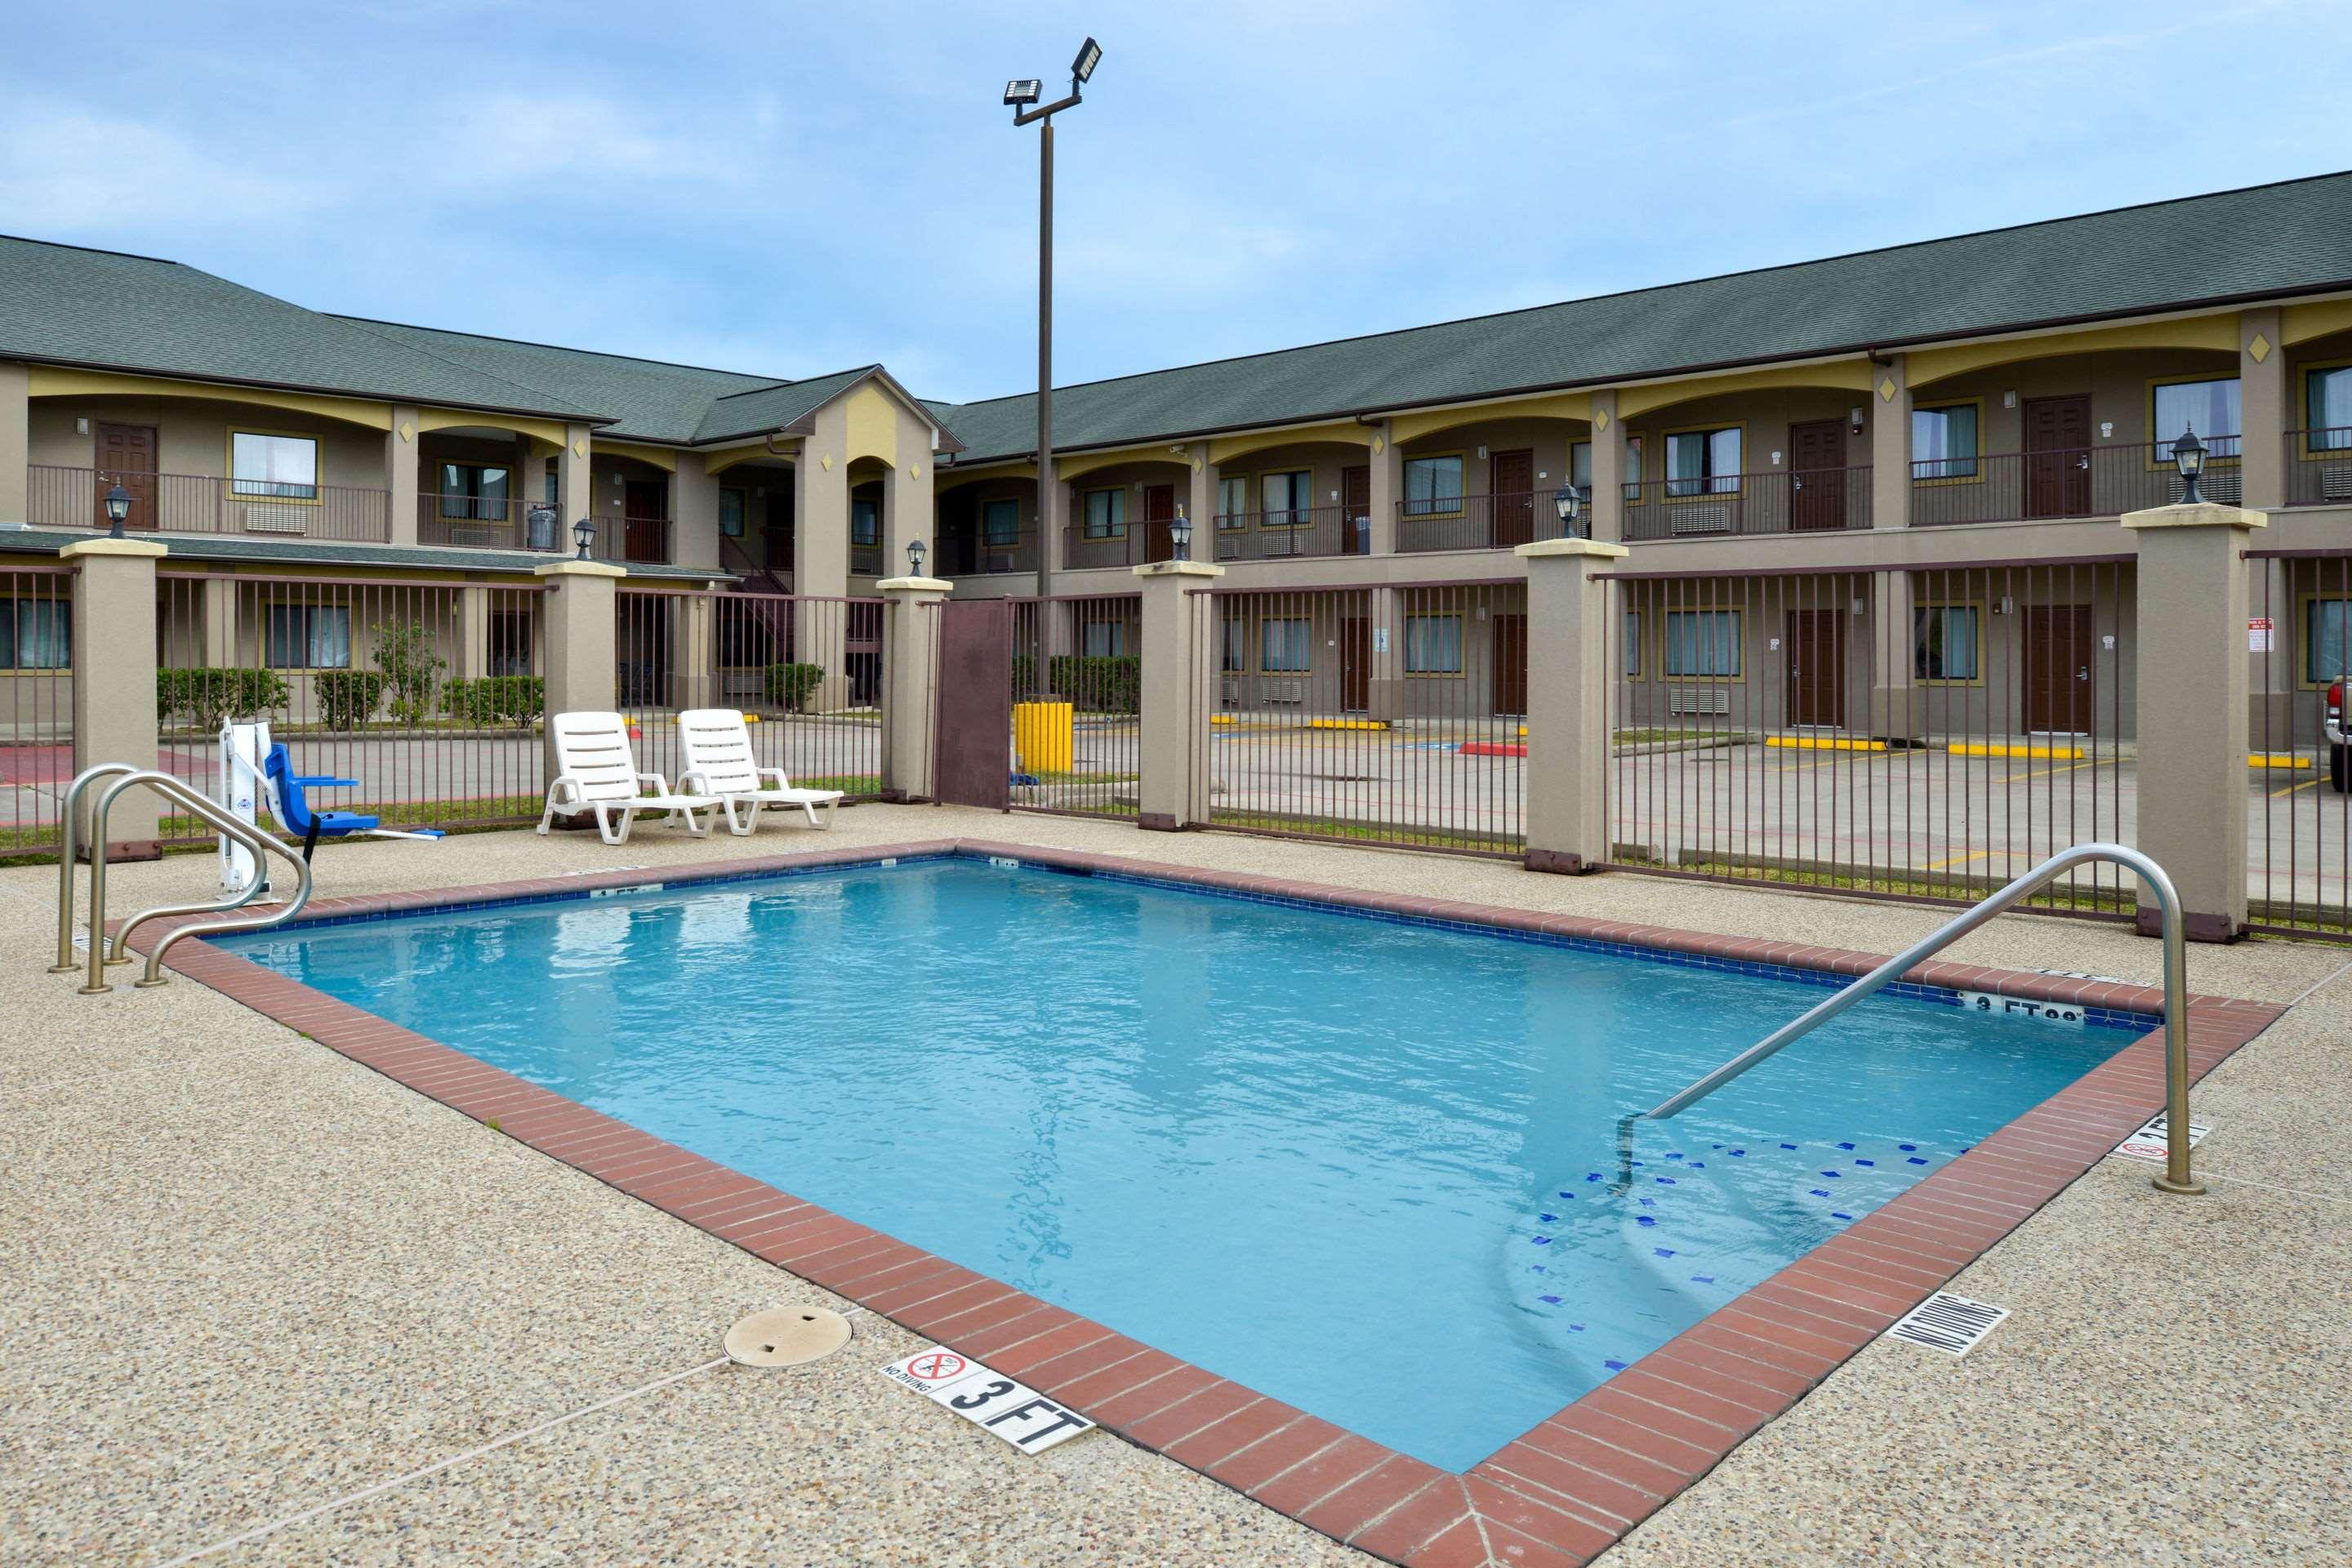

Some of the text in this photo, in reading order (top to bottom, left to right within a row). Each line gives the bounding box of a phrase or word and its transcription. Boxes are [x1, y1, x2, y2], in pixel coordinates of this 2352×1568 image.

[1893, 1294, 2003, 1352] NO DIVING
[882, 1365, 931, 1392] NO DIVING
[950, 1380, 1089, 1446] 3 FT
